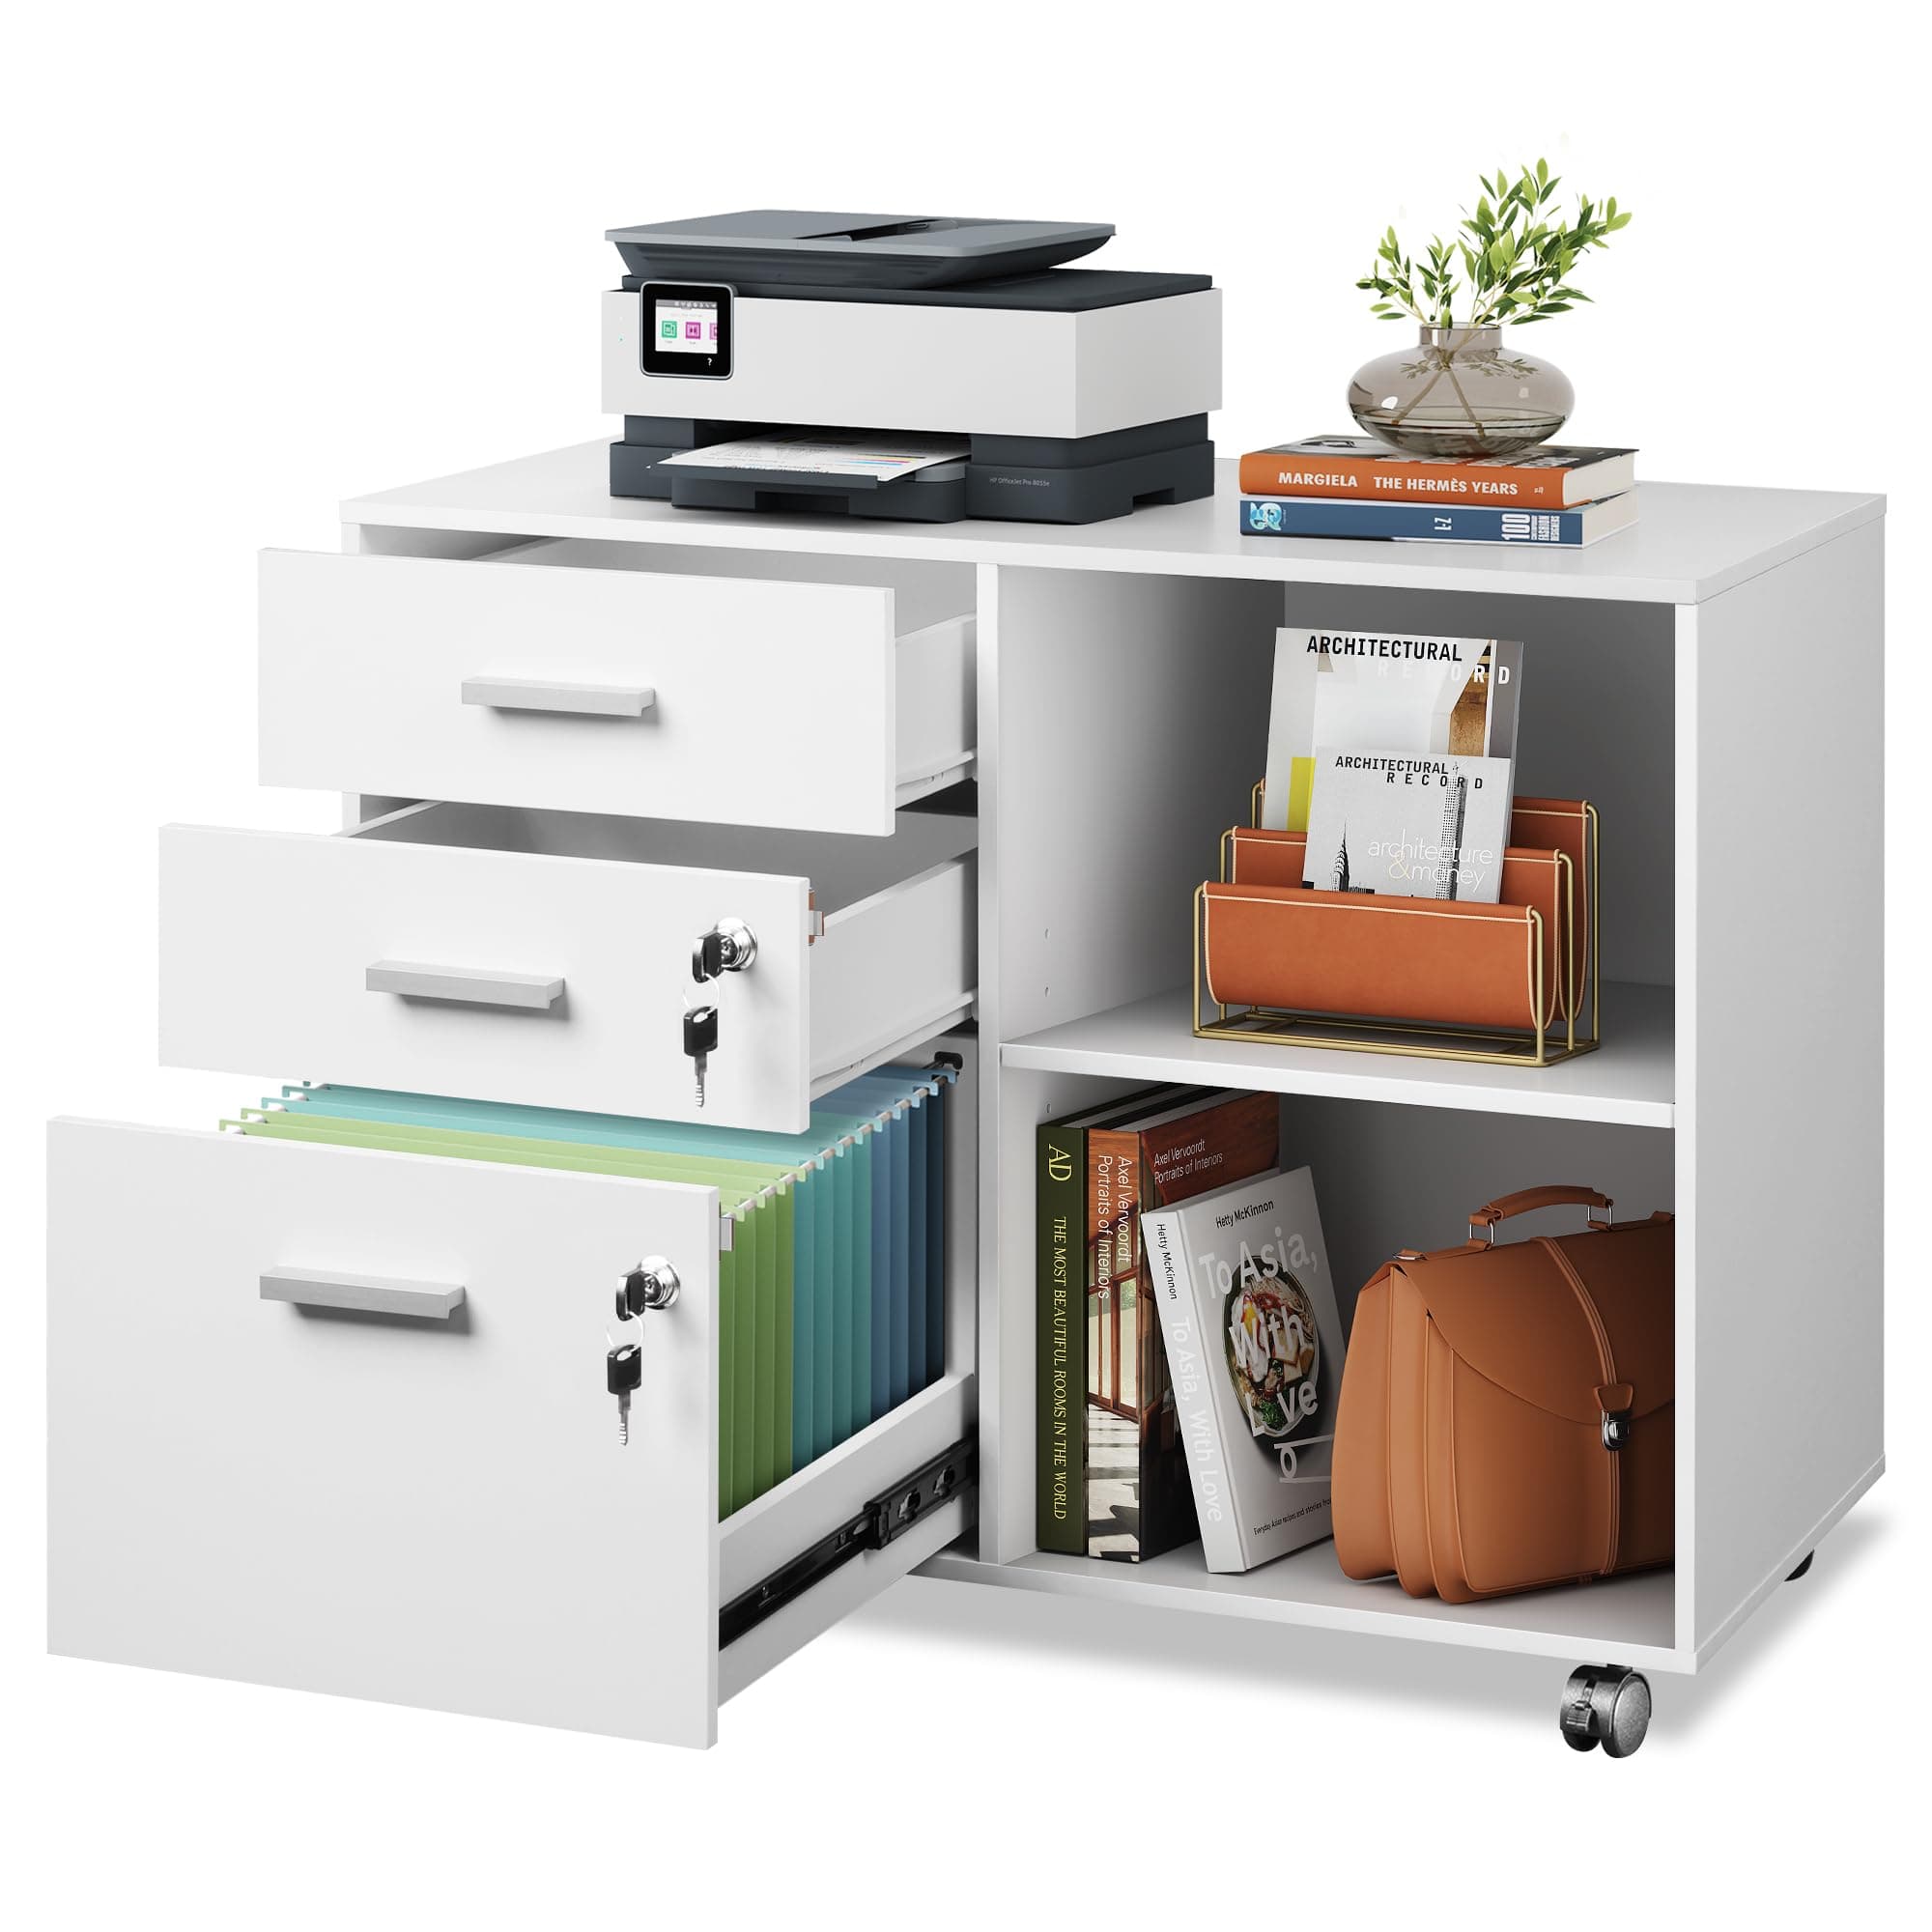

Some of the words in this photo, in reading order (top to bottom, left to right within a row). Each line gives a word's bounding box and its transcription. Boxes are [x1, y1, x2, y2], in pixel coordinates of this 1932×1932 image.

[1278, 471, 1358, 487] MARGIELA
[1374, 476, 1403, 490] THE
[1406, 477, 1467, 493] HERMÈS
[1471, 481, 1519, 496] YEARS
[1501, 514, 1530, 540] 100
[1306, 635, 1463, 662] ARCHITECTURAL
[1335, 755, 1449, 775] ARCHITECTURAL
[1386, 773, 1484, 789] RECORD
[1368, 828, 1494, 866] architecture
[1048, 1143, 1072, 1181] AD
[1118, 1155, 1132, 1188] Axel
[1153, 1148, 1171, 1167] Axel
[1170, 1138, 1206, 1160] Vervoordt
[1153, 1163, 1184, 1184] Portraits
[1185, 1159, 1193, 1176] of
[1194, 1152, 1223, 1173] Interiors
[1097, 1155, 1113, 1215] Portraits
[1054, 1216, 1066, 1243] THE
[1097, 1219, 1114, 1235] of
[1118, 1192, 1132, 1262] Vervoordt
[1215, 1212, 1234, 1229] Hetty
[1235, 1200, 1275, 1222] McKinnon
[1054, 1247, 1066, 1287] MOST
[1097, 1239, 1114, 1299] Interiors
[1156, 1223, 1168, 1249] Hetty
[1162, 1252, 1178, 1300] McKinnon
[1198, 1252, 1233, 1299] To
[1239, 1226, 1319, 1289] Asia,
[1054, 1290, 1066, 1365] BEAUTIFUL
[1171, 1316, 1191, 1343] To
[1228, 1305, 1304, 1370] With
[1176, 1346, 1201, 1402] Asia,
[1054, 1371, 1066, 1418] ROOMS
[1054, 1422, 1066, 1436] IN
[1188, 1409, 1215, 1462] With
[1054, 1436, 1066, 1466] THE
[1054, 1471, 1066, 1520] WORLD
[1199, 1470, 1223, 1522] Love
